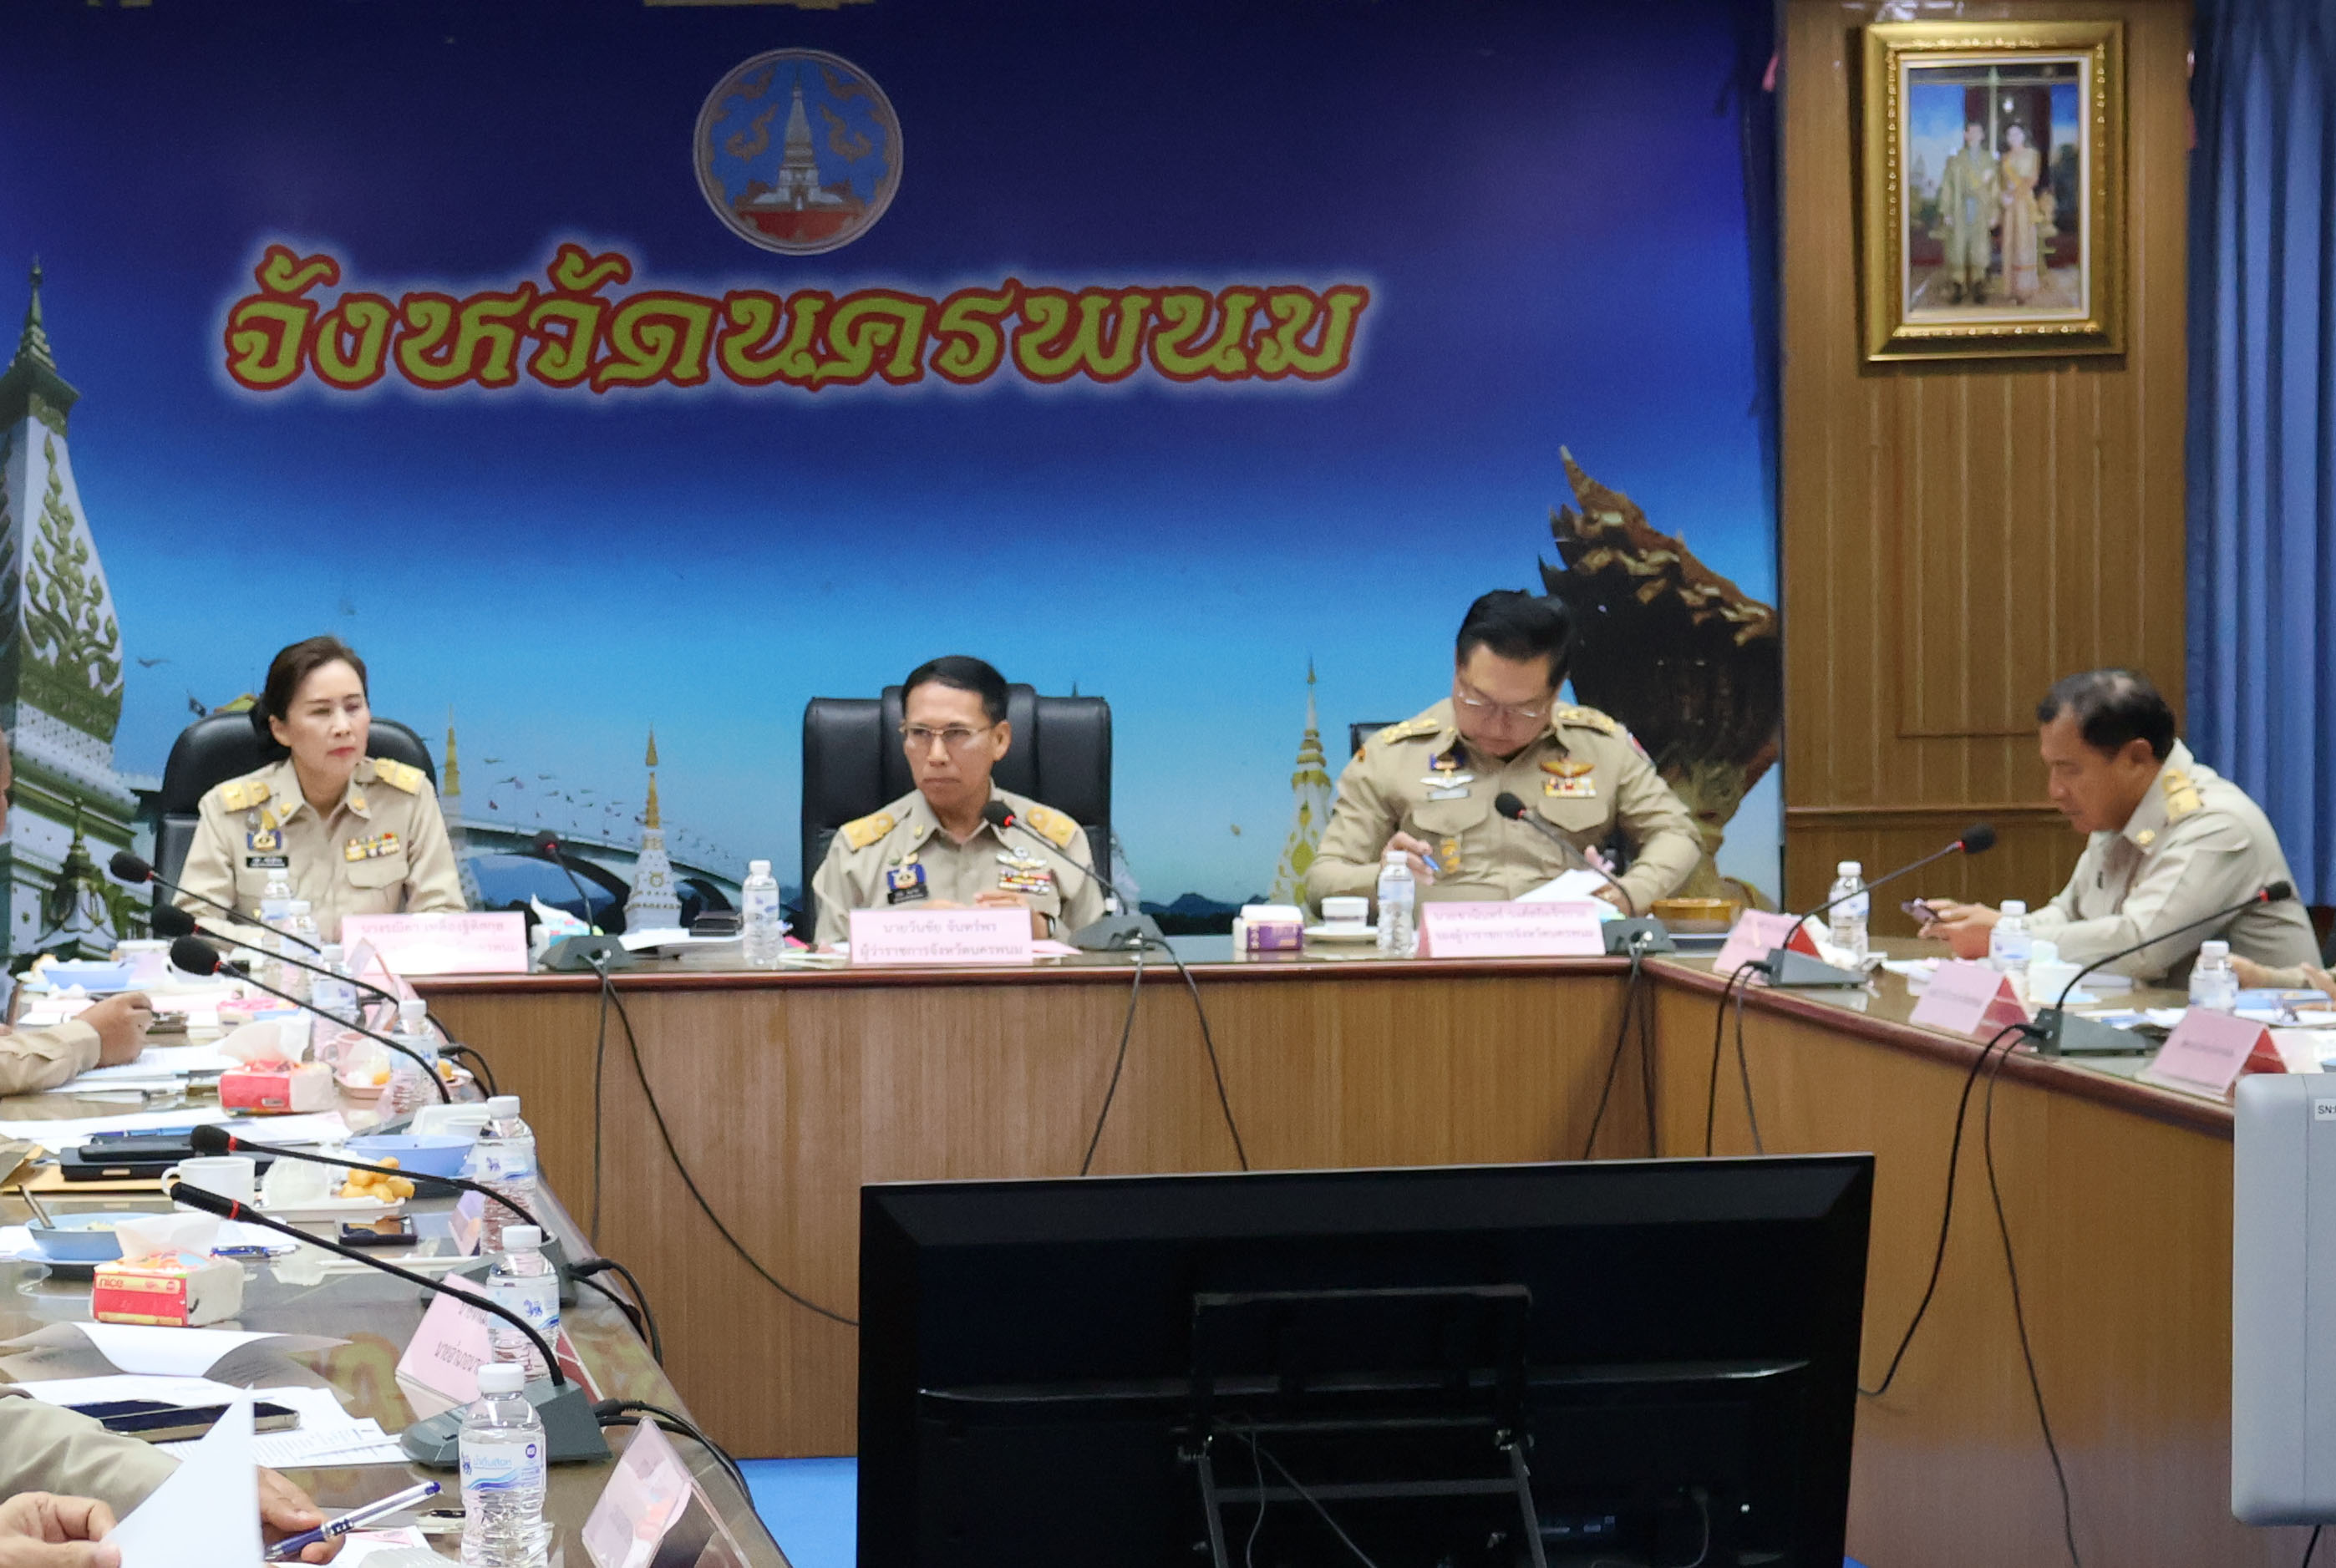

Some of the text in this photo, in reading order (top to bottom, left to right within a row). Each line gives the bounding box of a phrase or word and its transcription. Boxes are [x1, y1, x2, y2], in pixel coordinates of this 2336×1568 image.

[225, 242, 1370, 393] จังหวัดนครพนม
